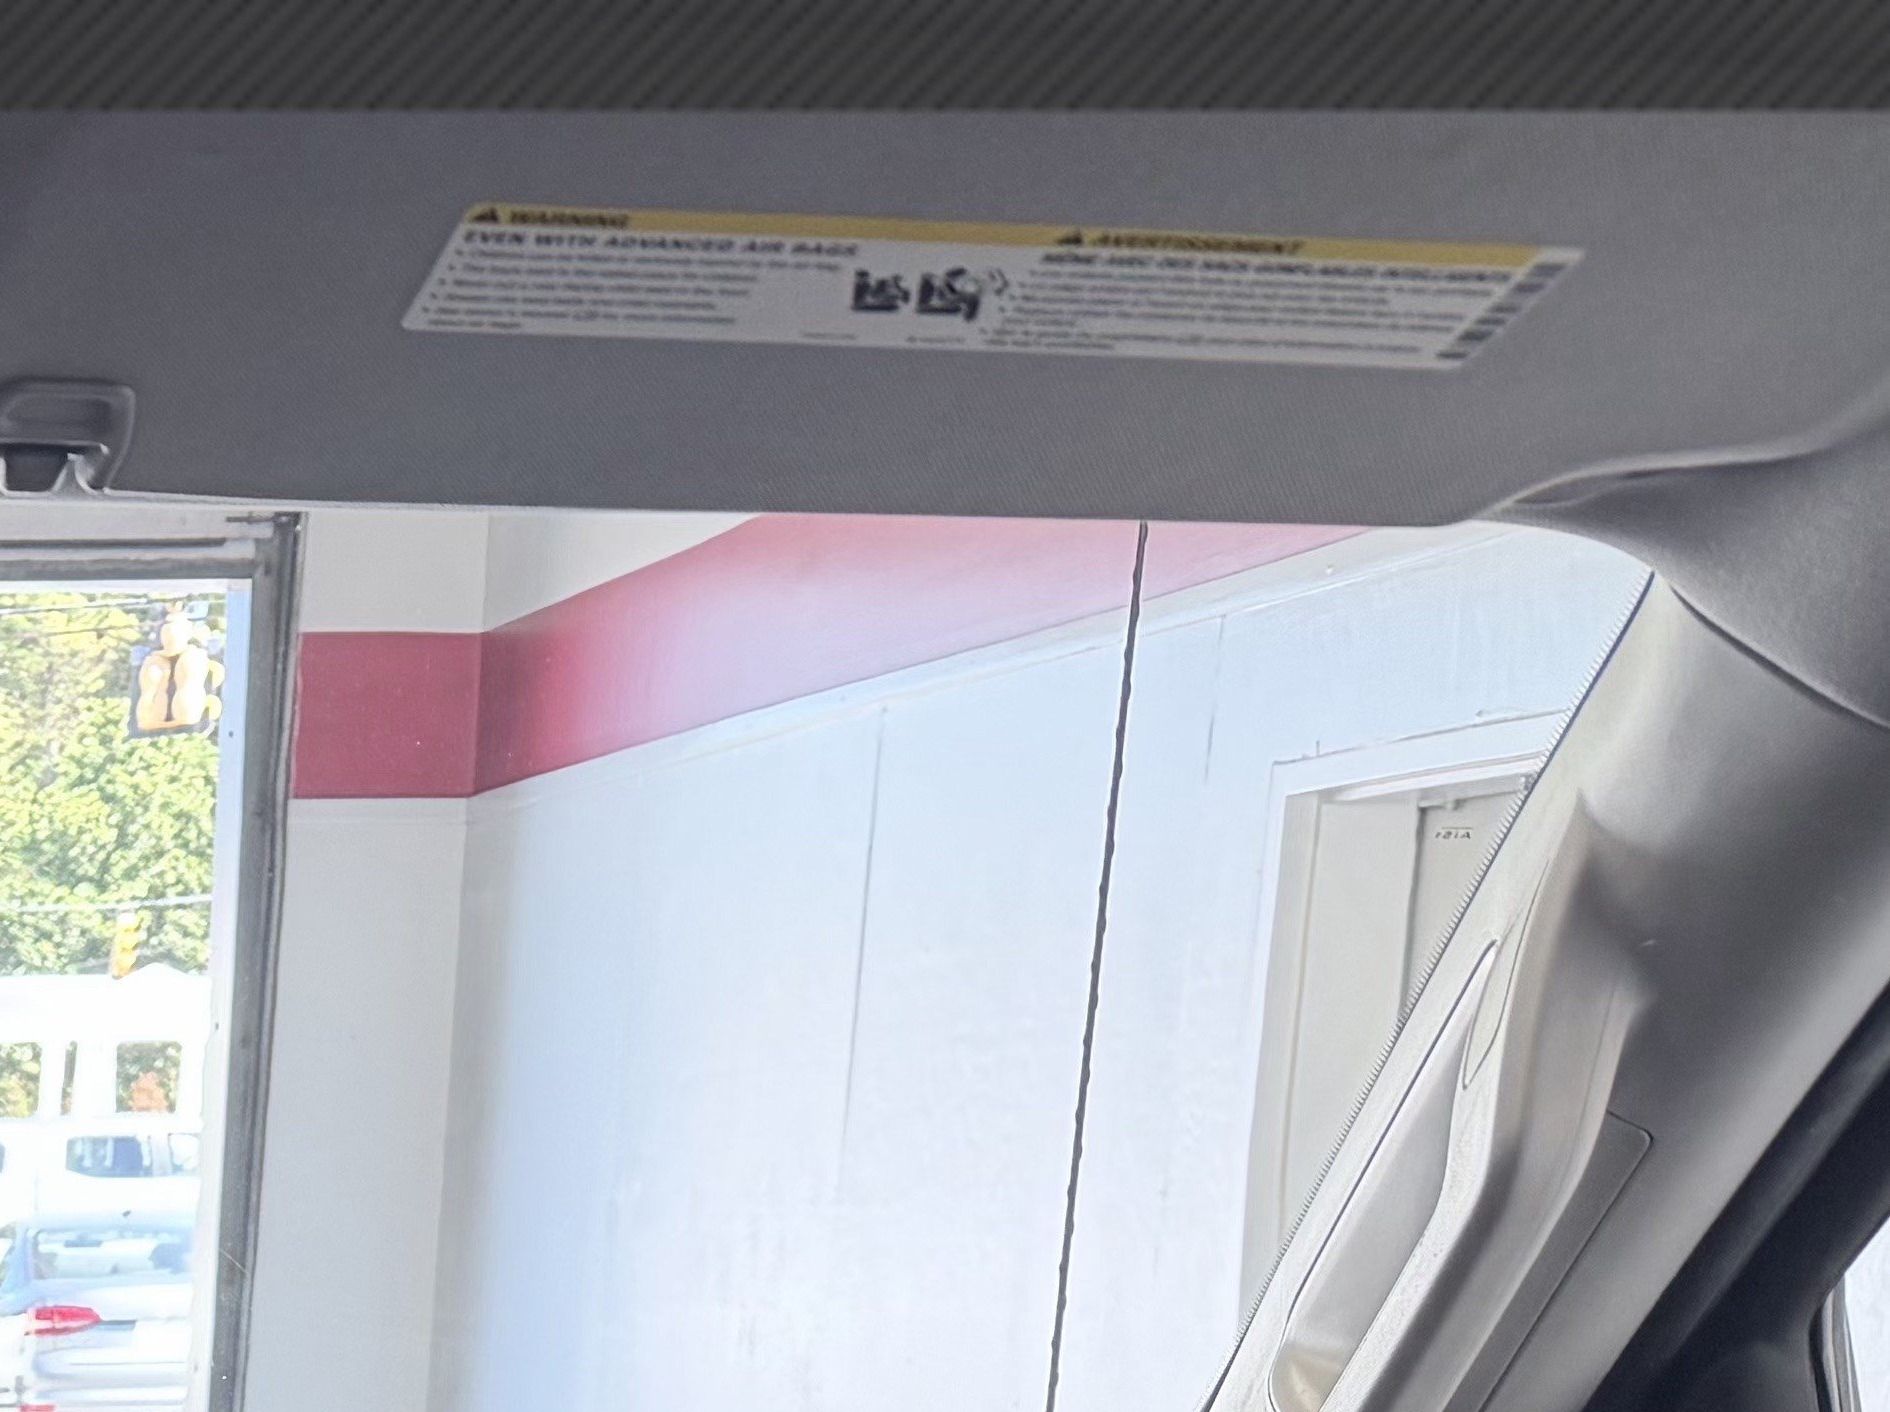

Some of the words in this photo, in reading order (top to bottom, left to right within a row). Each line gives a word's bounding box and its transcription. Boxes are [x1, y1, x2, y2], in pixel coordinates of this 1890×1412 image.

[463, 230, 524, 244] EVEN
[534, 232, 597, 247] WITH
[740, 239, 785, 253] AIR
